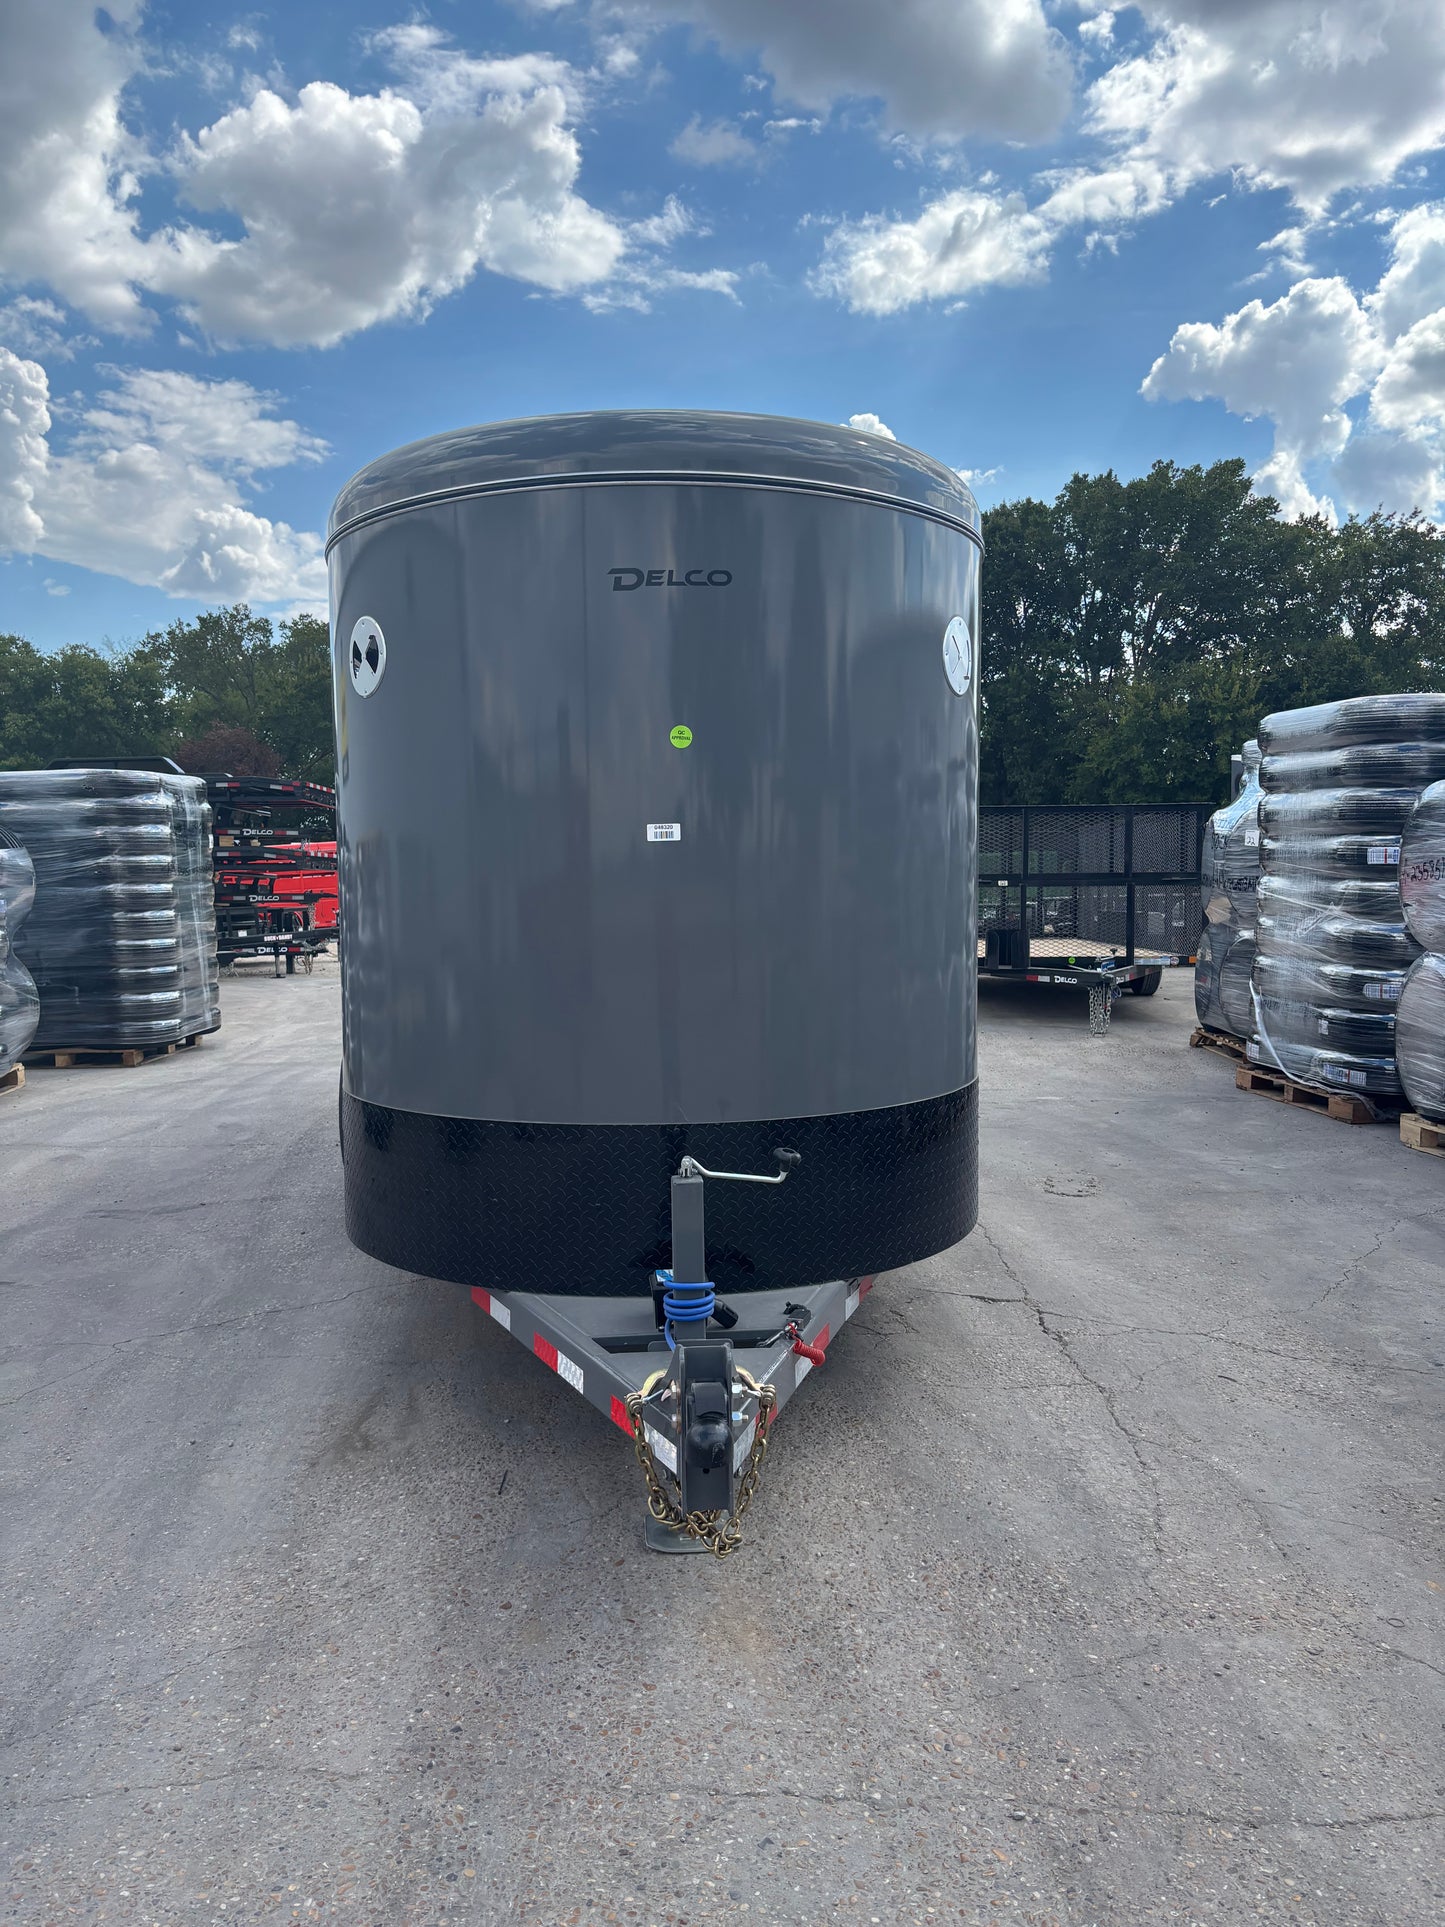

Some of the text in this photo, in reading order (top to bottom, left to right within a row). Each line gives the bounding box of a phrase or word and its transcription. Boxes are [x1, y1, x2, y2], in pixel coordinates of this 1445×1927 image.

[607, 567, 733, 592] DELCO
[242, 828, 274, 836] DELCO
[248, 894, 280, 902] DELCO
[1054, 975, 1078, 984] DELCO
